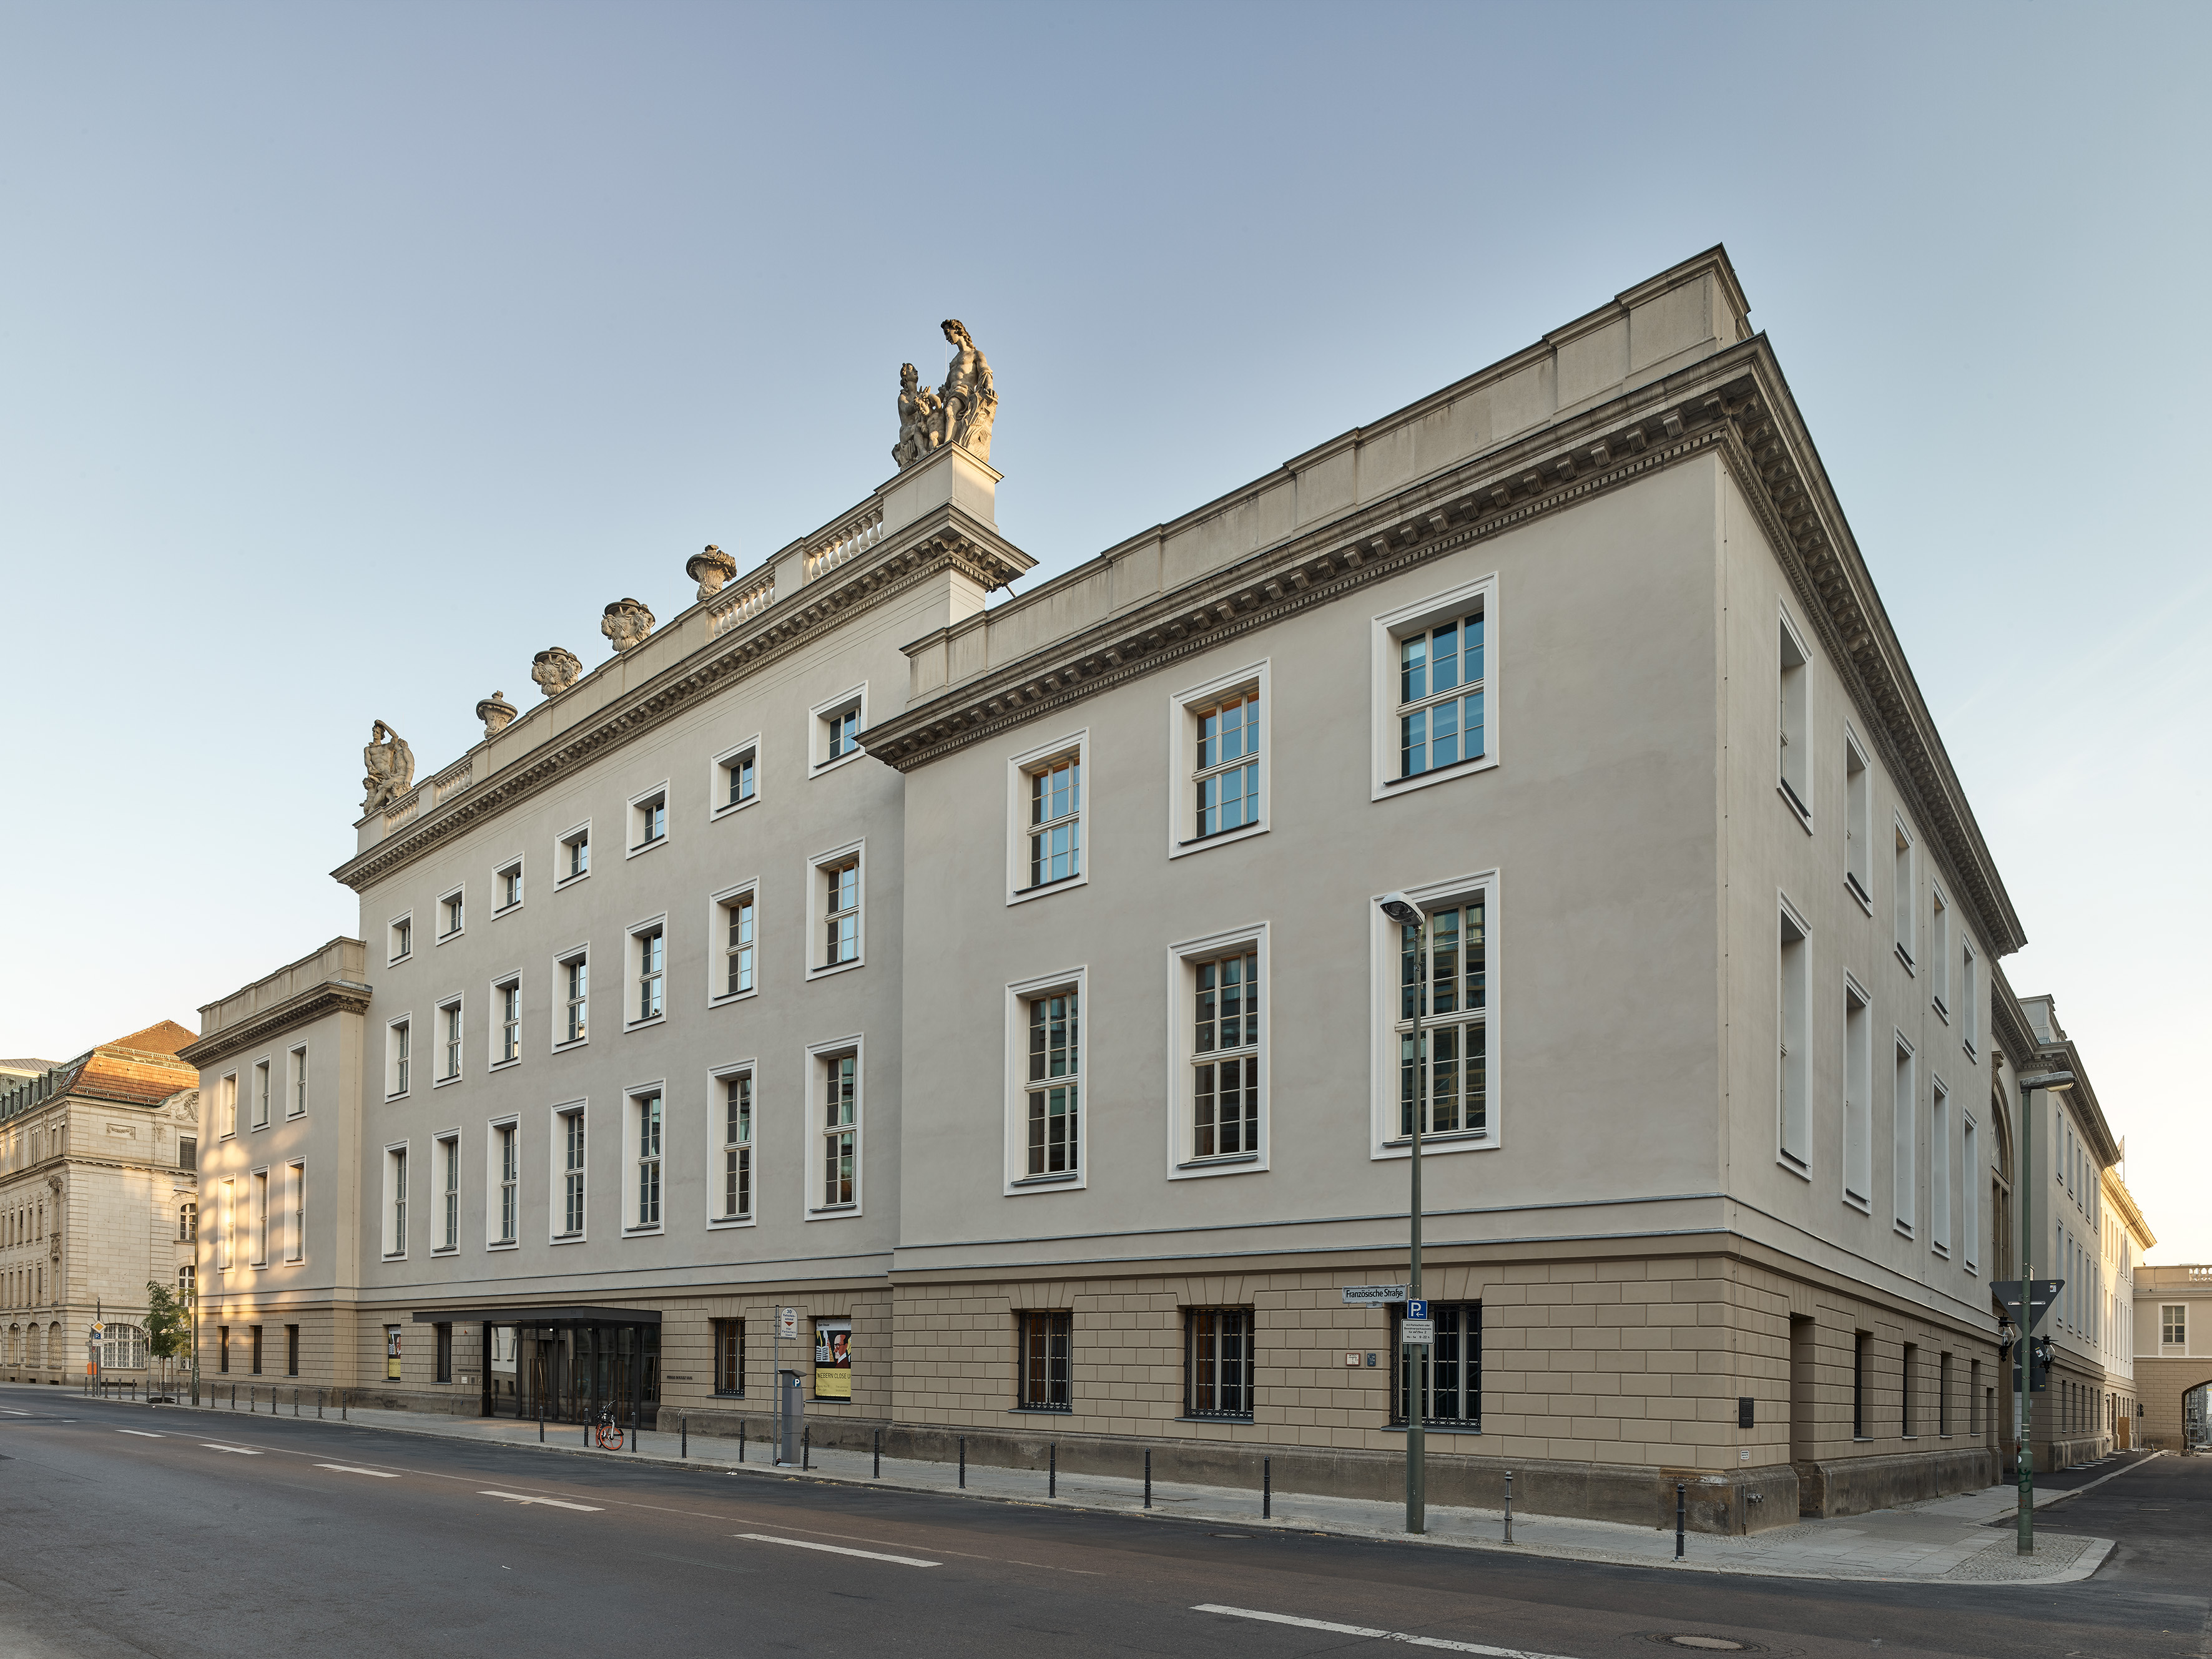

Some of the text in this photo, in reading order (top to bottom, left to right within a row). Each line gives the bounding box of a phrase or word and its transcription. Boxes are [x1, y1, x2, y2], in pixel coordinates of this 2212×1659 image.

[1346, 1288, 1403, 1298] Französische Straße
[1411, 1302, 1422, 1317] P
[795, 1379, 800, 1387] P
